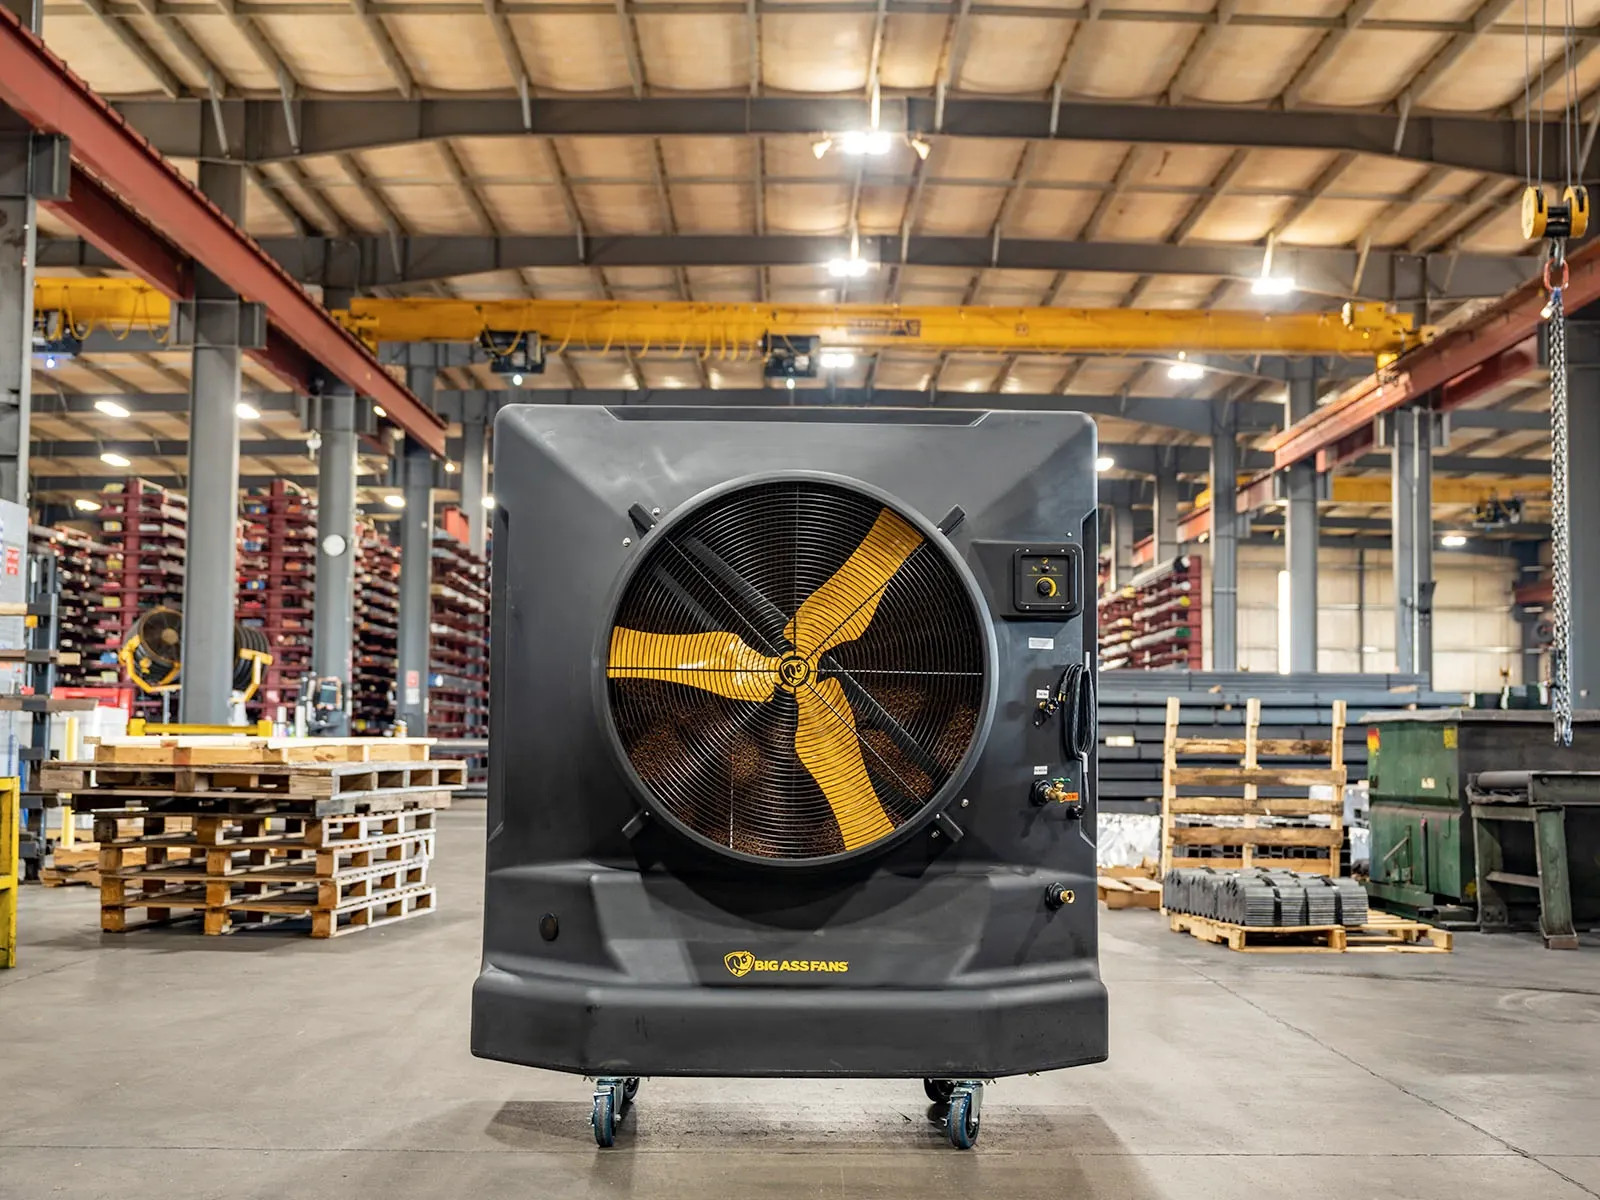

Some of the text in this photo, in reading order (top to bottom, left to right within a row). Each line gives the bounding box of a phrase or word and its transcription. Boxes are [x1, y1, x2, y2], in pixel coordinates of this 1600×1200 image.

[754, 960, 848, 972] BIG ASS FANS
